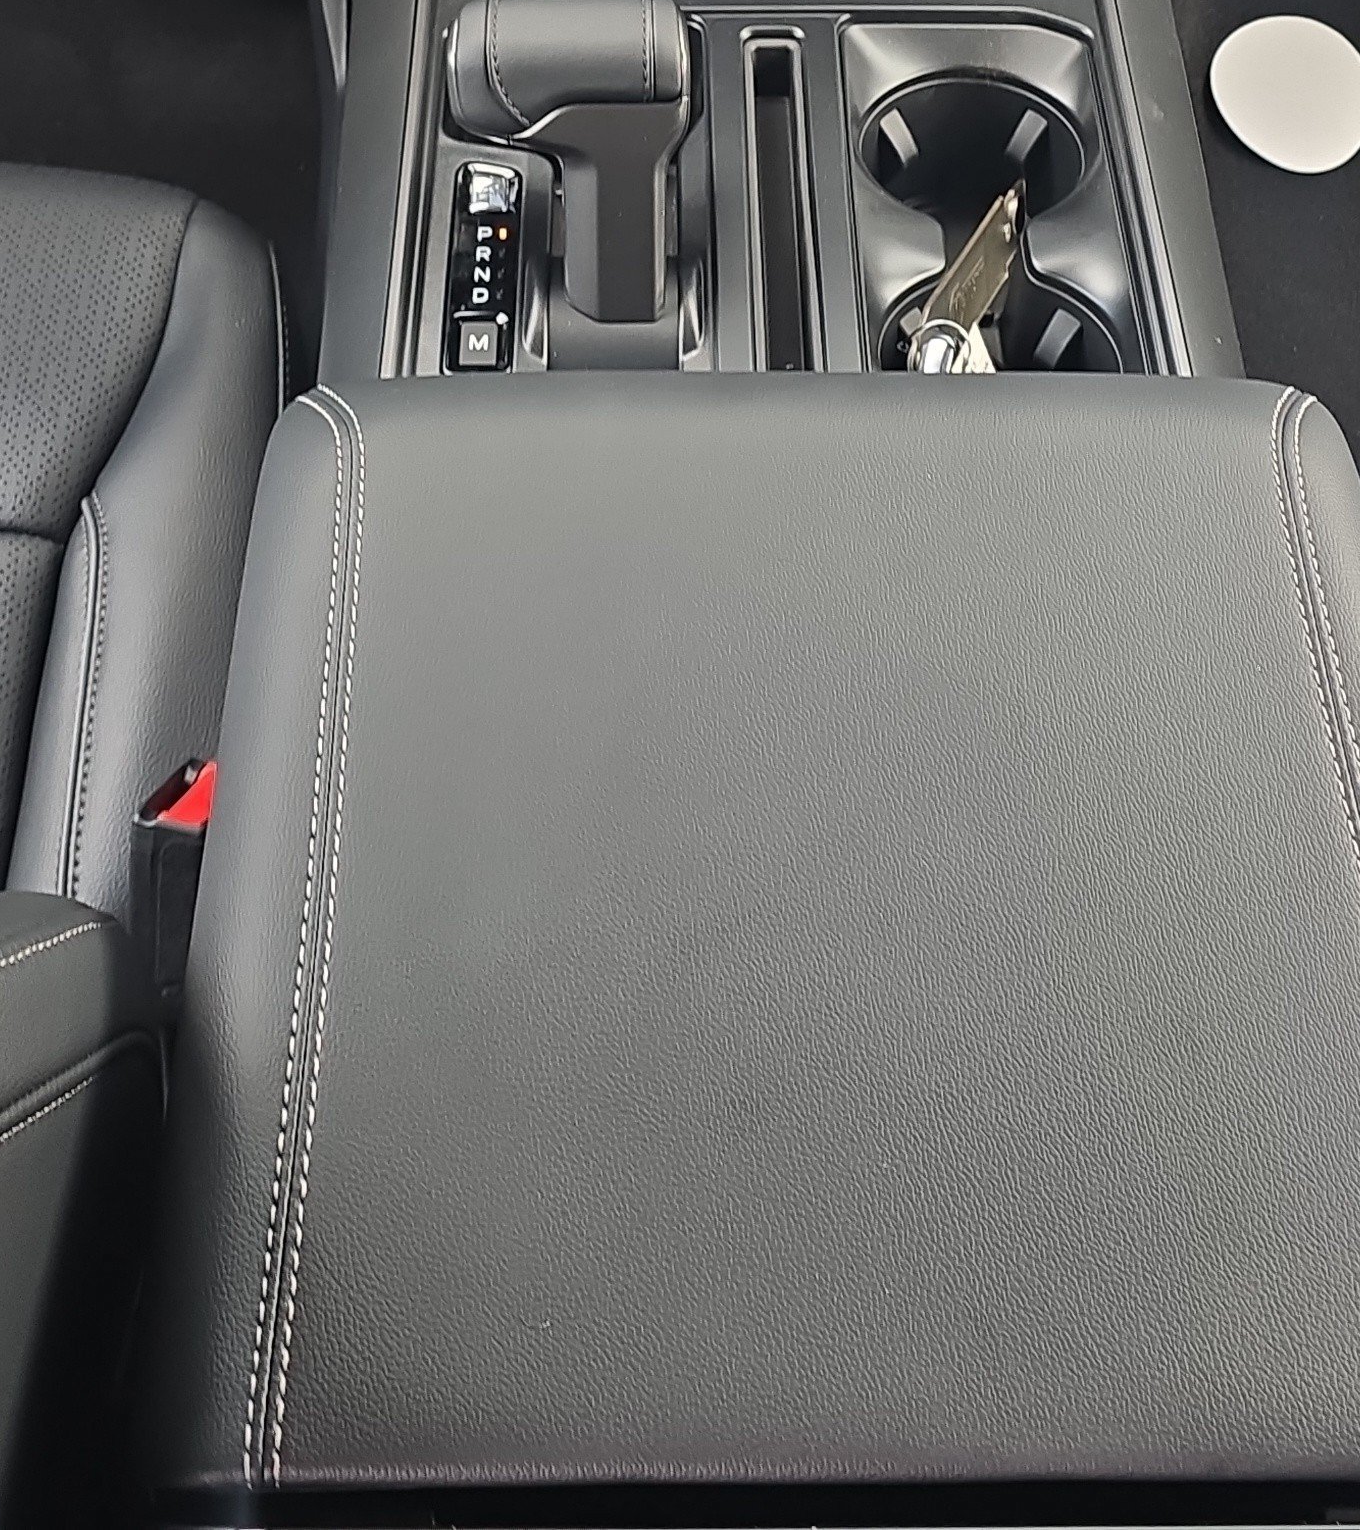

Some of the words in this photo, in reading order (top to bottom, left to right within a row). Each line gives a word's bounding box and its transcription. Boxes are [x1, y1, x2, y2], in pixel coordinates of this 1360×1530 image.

[477, 226, 493, 241] P
[476, 246, 492, 262] R
[474, 267, 491, 282] N
[472, 287, 489, 304] D
[468, 335, 489, 351] M
